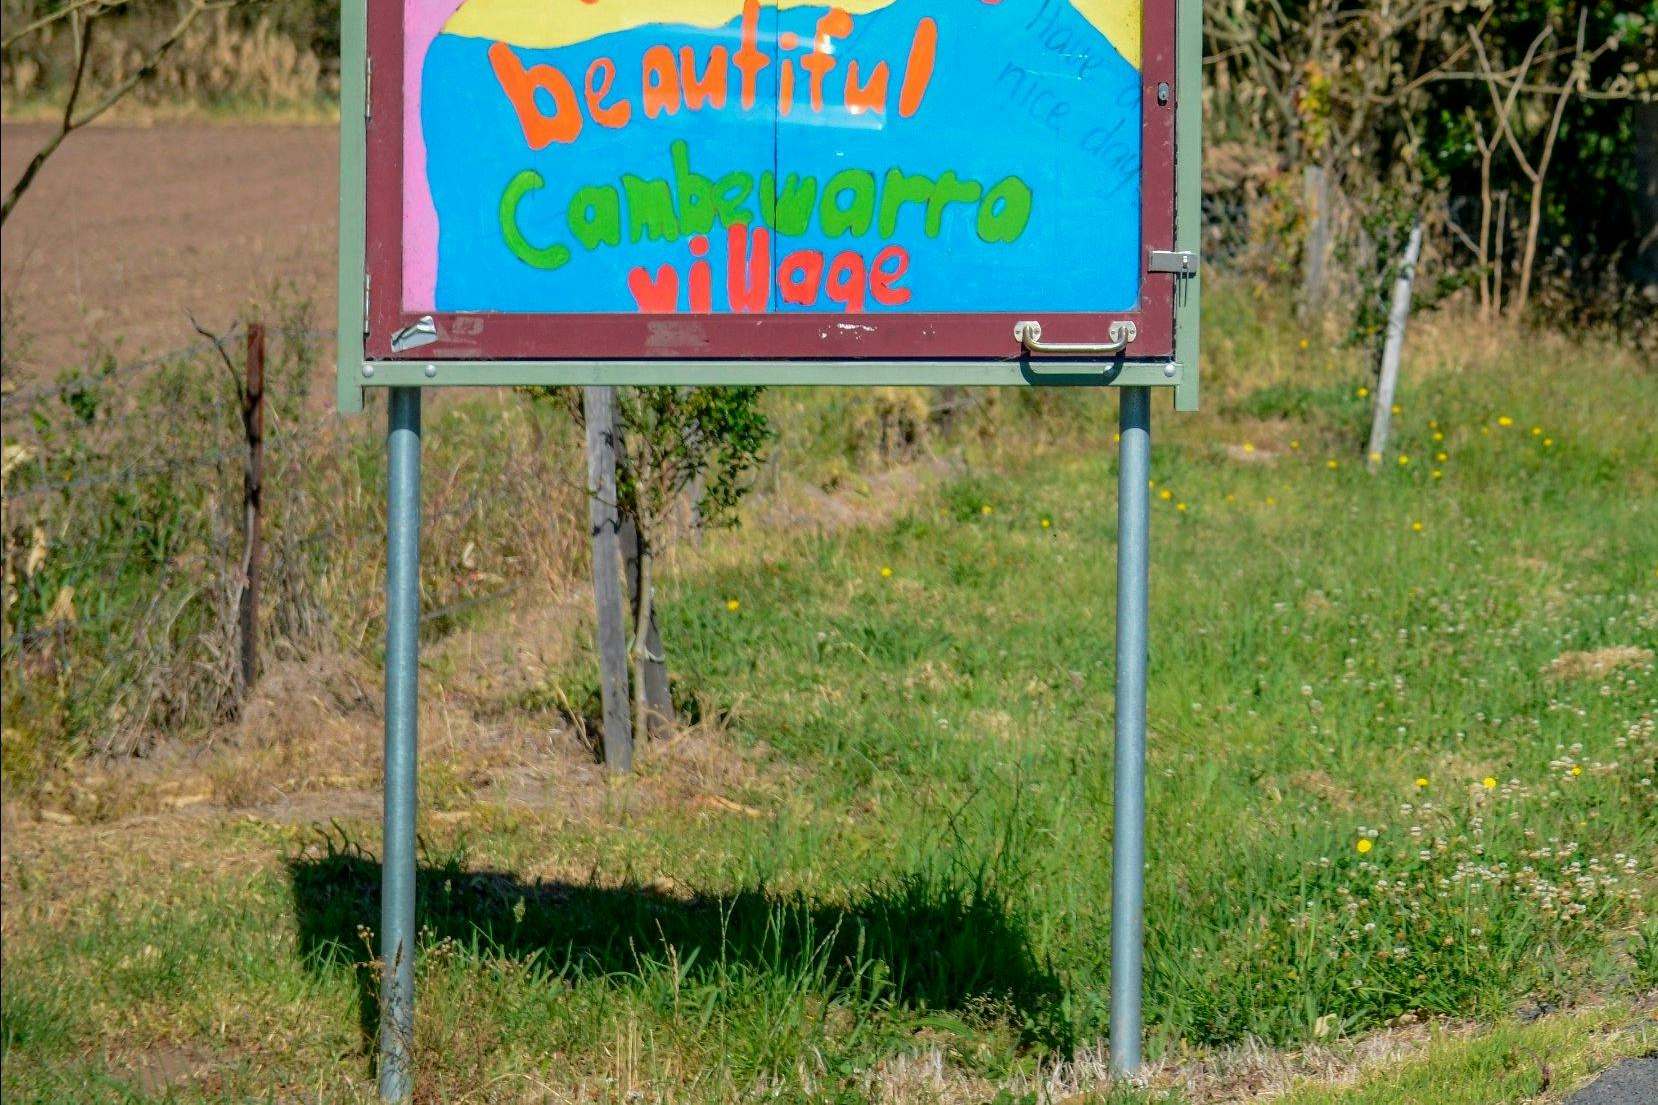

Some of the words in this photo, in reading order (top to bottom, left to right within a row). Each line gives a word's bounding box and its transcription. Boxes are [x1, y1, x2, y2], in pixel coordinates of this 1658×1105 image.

[993, 61, 1071, 131] nice
[1080, 117, 1142, 199] day
[627, 223, 912, 314] village
